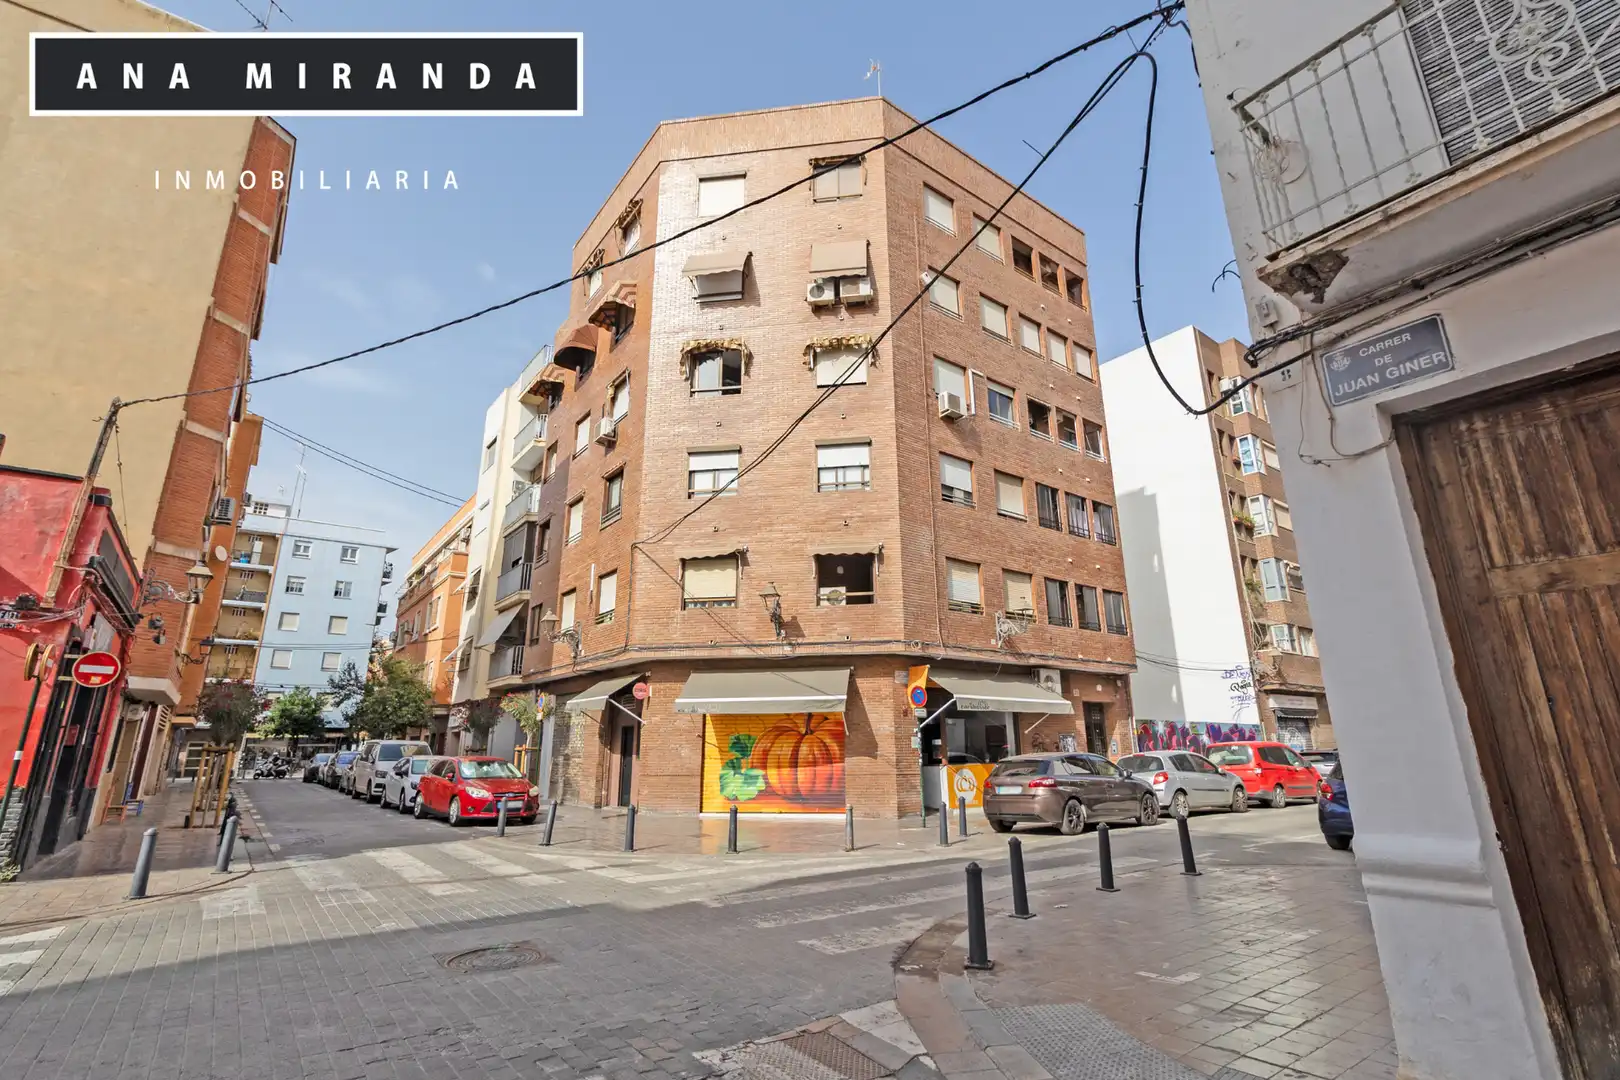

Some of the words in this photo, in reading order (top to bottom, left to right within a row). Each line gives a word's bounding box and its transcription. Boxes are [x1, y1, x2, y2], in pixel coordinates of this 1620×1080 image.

[1359, 332, 1412, 357] CARRER
[1374, 353, 1393, 367] DE
[1335, 372, 1380, 396] JUAN
[1385, 351, 1446, 379] GINER
